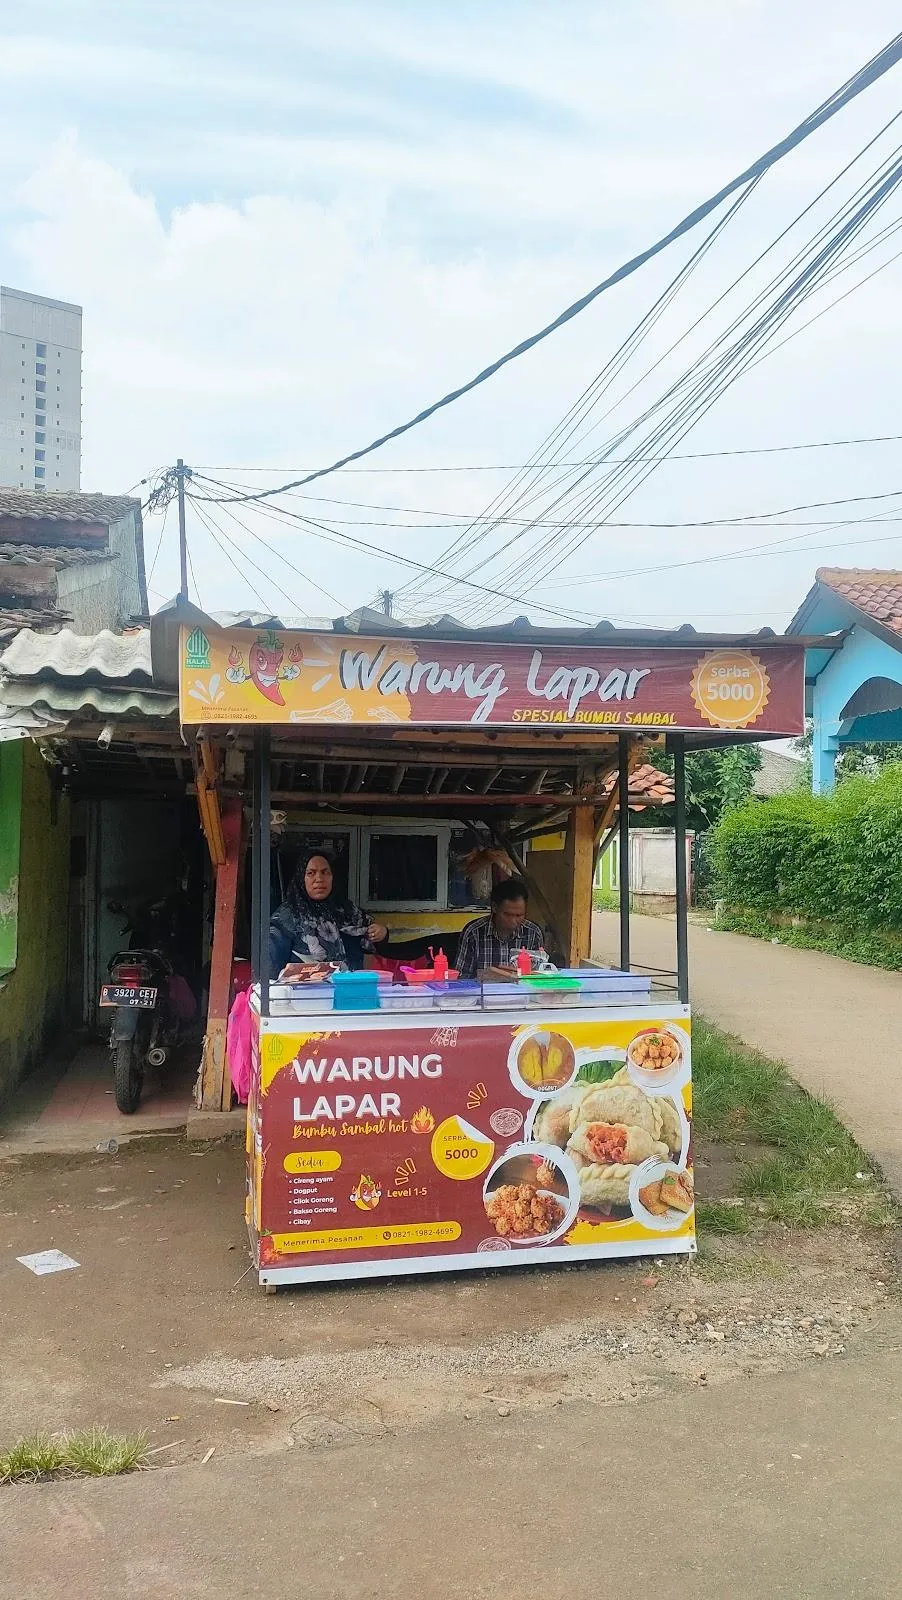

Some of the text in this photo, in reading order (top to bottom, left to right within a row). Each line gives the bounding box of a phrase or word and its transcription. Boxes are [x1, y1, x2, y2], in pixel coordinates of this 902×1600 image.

[339, 645, 508, 724] Warung
[706, 682, 754, 702] 5000
[511, 709, 677, 725] SPESIAL BUMBU SAMBAL
[103, 988, 108, 996] B
[114, 989, 135, 997] 3920
[293, 1054, 443, 1083] WARUNG
[293, 1093, 401, 1121] LAPAR
[292, 1119, 408, 1139] Bumbu Sambal hot
[296, 1156, 324, 1168] Sedia
[445, 1148, 478, 1160] 5000
[293, 1187, 318, 1195] Dogput
[387, 1187, 428, 1198] Level 1-5
[283, 1238, 325, 1247] Menerima
[328, 1235, 363, 1243] Pesanan
[392, 1227, 454, 1238] 0821-1982-4695
